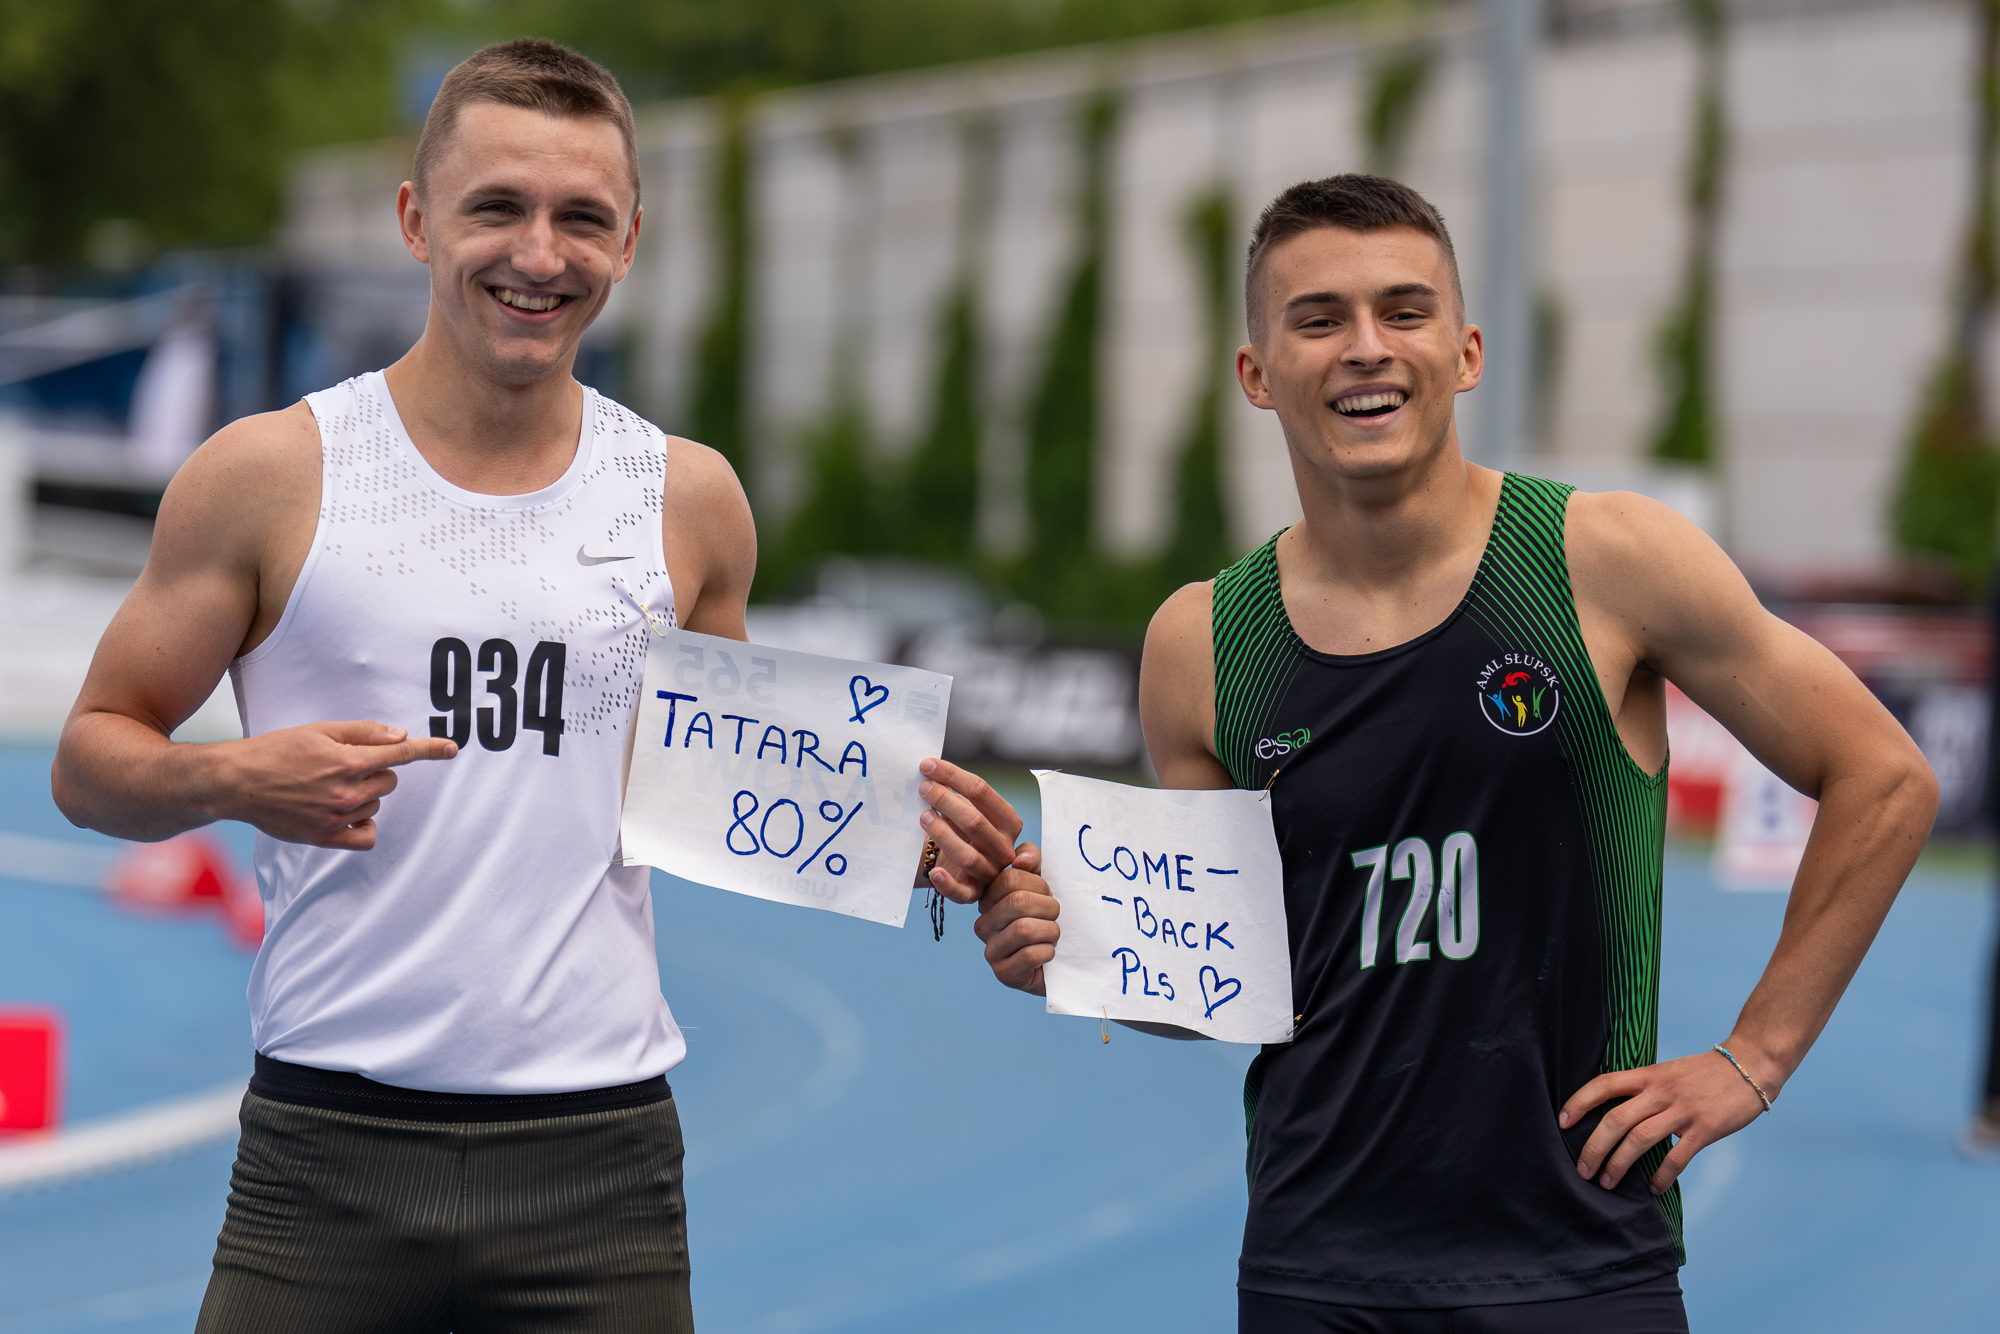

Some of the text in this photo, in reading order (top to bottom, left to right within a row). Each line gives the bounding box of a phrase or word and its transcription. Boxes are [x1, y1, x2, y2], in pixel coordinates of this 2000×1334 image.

[429, 637, 566, 757] 934
[1476, 653, 1560, 690] AML SŁUPSK
[656, 690, 867, 777] TATARA
[1255, 727, 1311, 759] esa
[726, 790, 863, 876] 80%
[1350, 830, 1480, 970] 720
